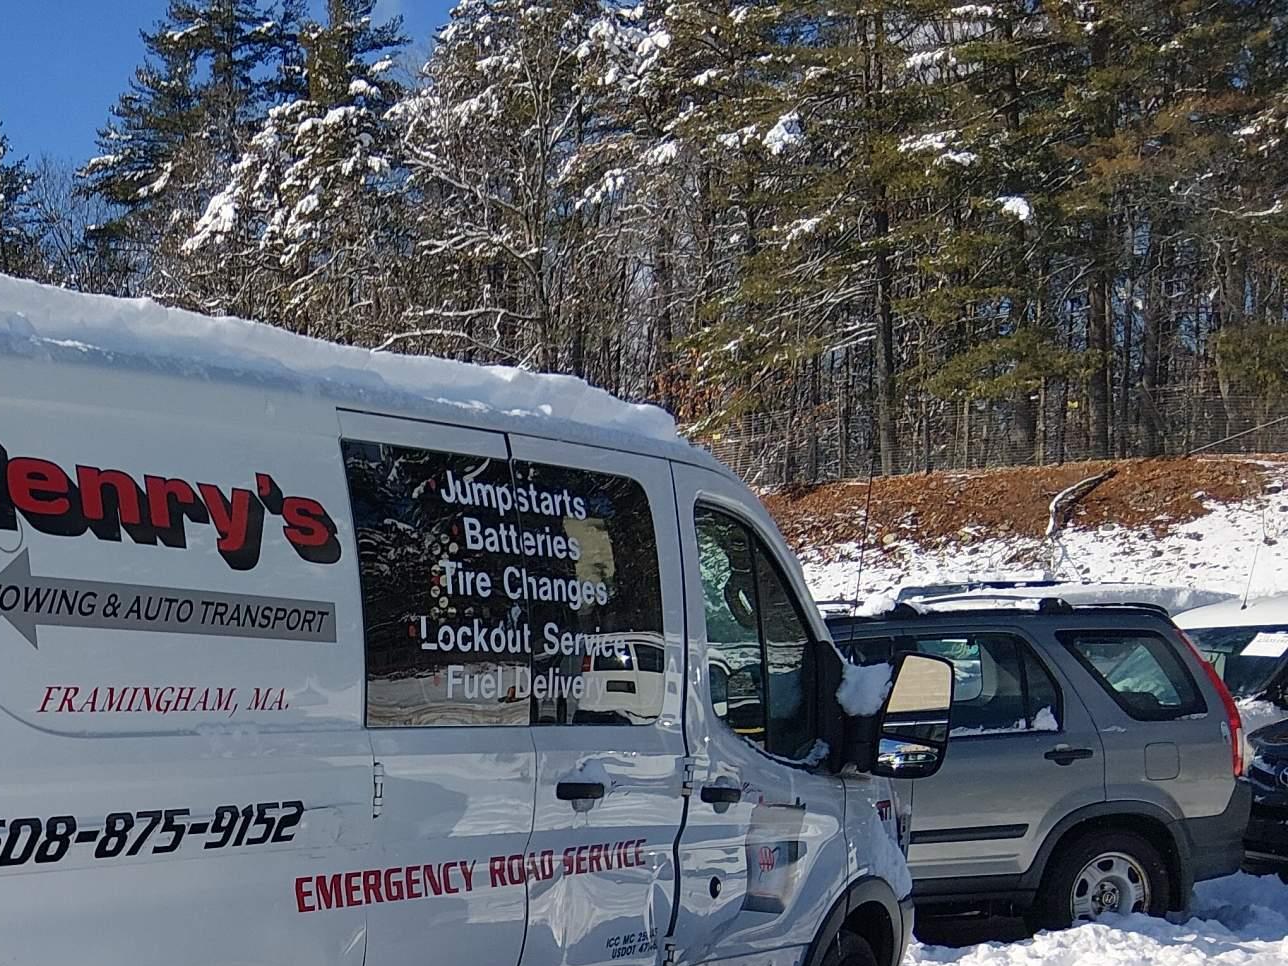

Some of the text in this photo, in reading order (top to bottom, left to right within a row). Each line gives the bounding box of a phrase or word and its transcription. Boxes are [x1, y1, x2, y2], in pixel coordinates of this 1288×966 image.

[440, 470, 587, 520] Jumpstarts
[463, 516, 581, 561] Batteries
[442, 561, 608, 610] Tire Changes
[102, 594, 121, 619] &
[124, 595, 194, 624] AUTO
[199, 600, 329, 635] TRANSPORT
[420, 616, 531, 653] Lockout
[37, 686, 290, 718] FRAMINGHAM, MA.
[447, 664, 503, 699] Fuel
[294, 838, 647, 913] EMERGENCY ROAD SERVICE
